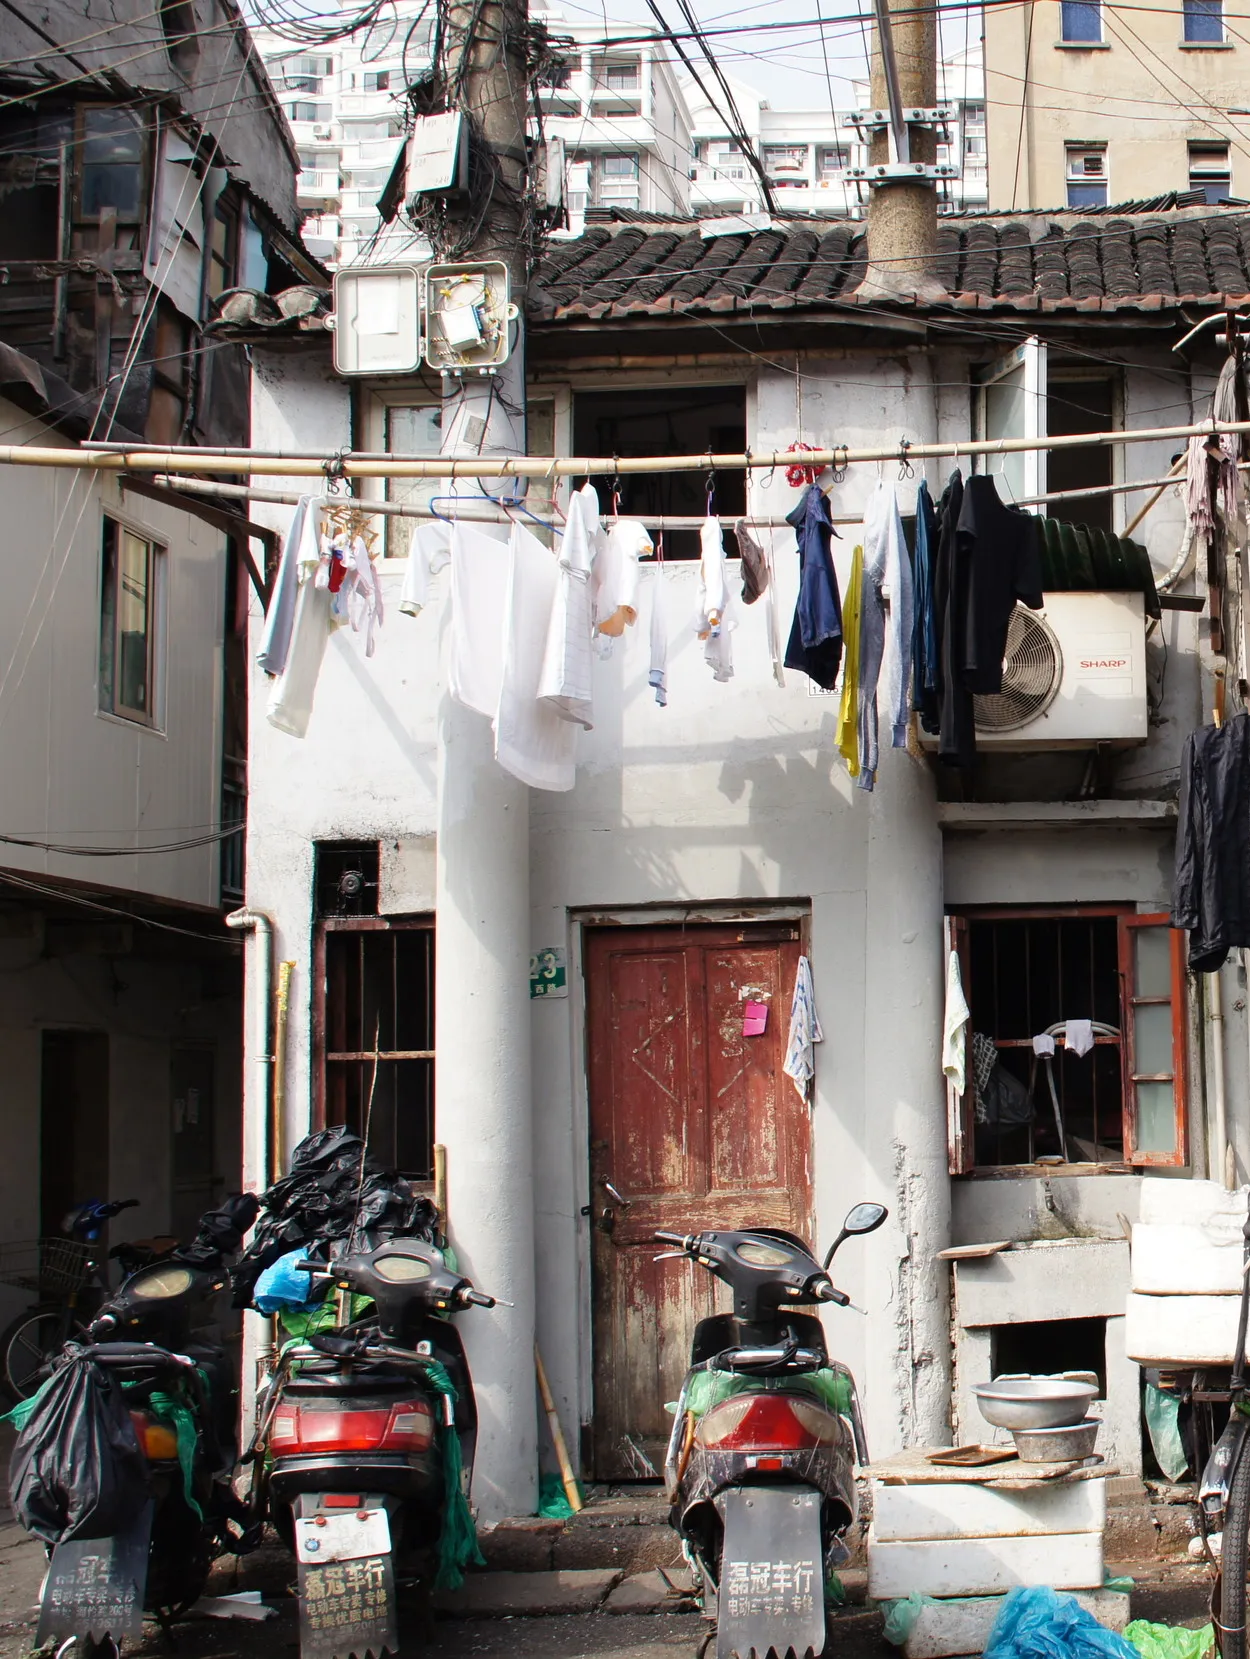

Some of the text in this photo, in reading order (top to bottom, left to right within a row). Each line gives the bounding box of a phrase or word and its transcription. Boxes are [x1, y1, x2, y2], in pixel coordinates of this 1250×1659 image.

[1080, 660, 1126, 669] SHARP
[728, 1560, 814, 1595] 磊冠车行
